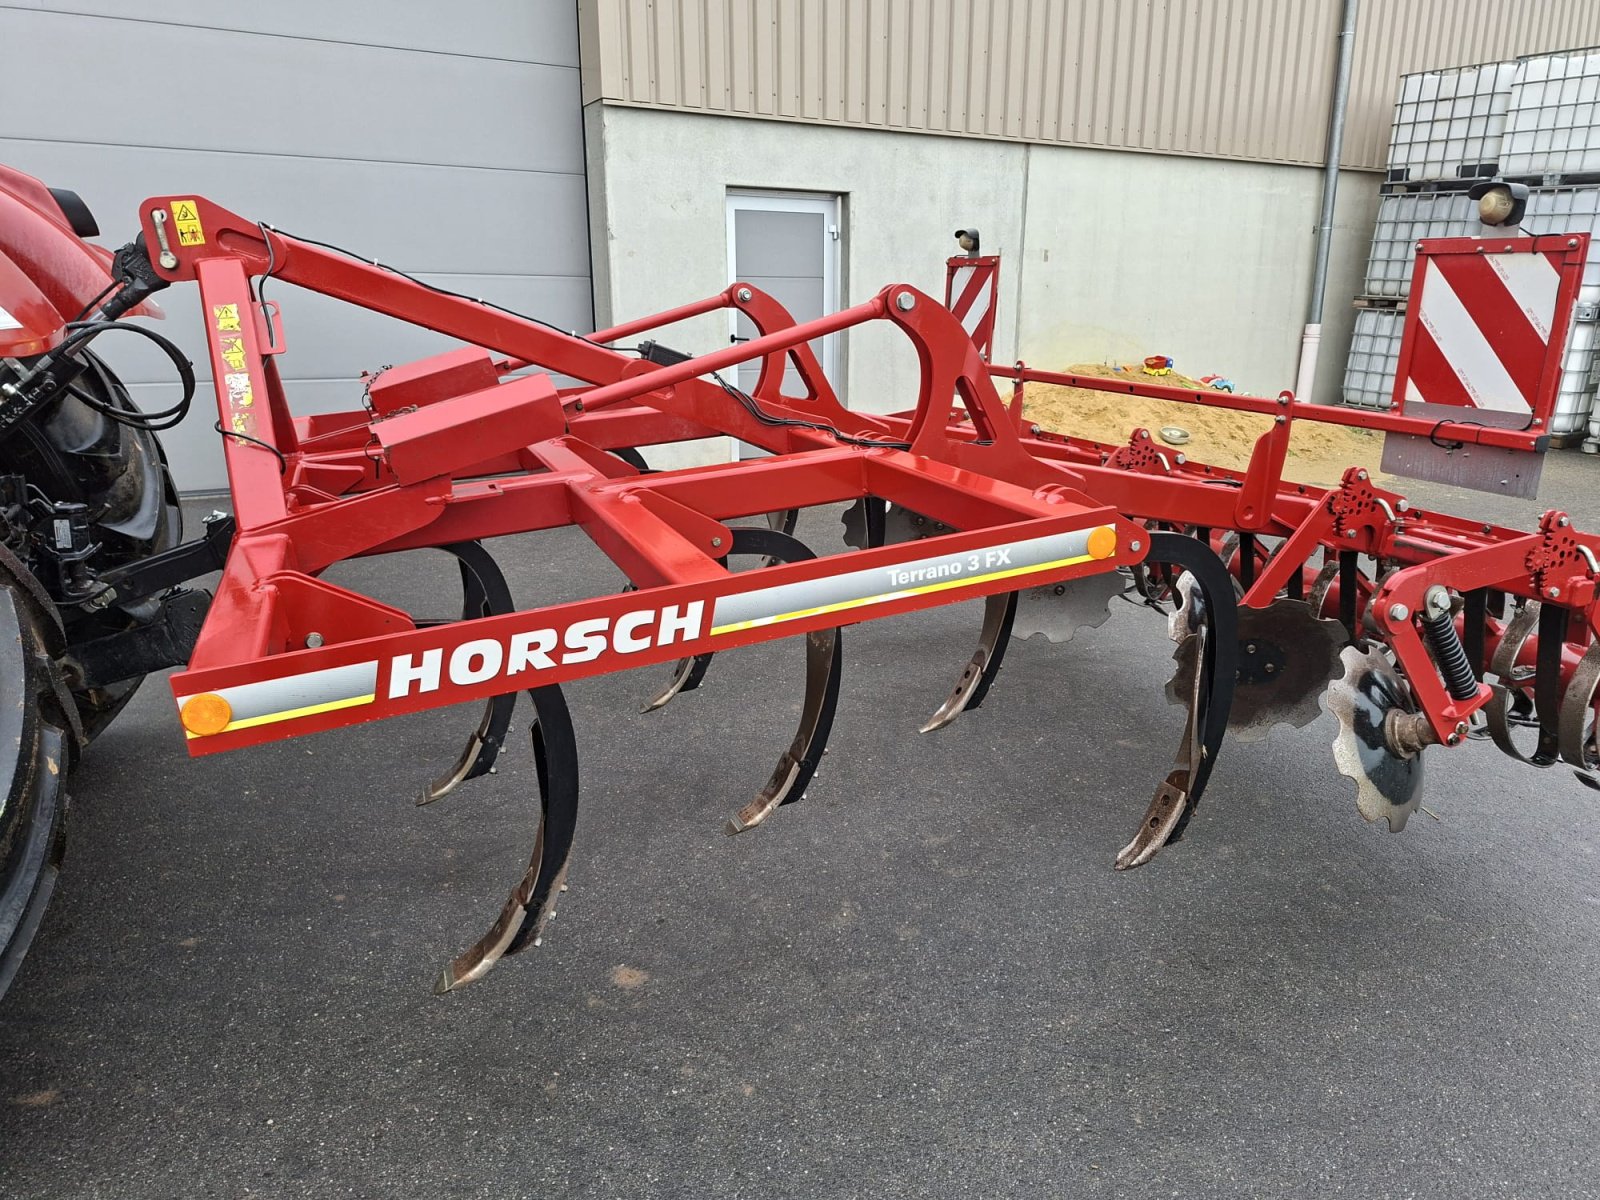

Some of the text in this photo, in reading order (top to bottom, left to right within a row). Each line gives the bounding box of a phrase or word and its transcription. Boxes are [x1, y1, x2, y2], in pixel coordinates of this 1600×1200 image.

[887, 549, 1012, 586] Terrano 3 FX
[388, 600, 704, 699] HORSCH
